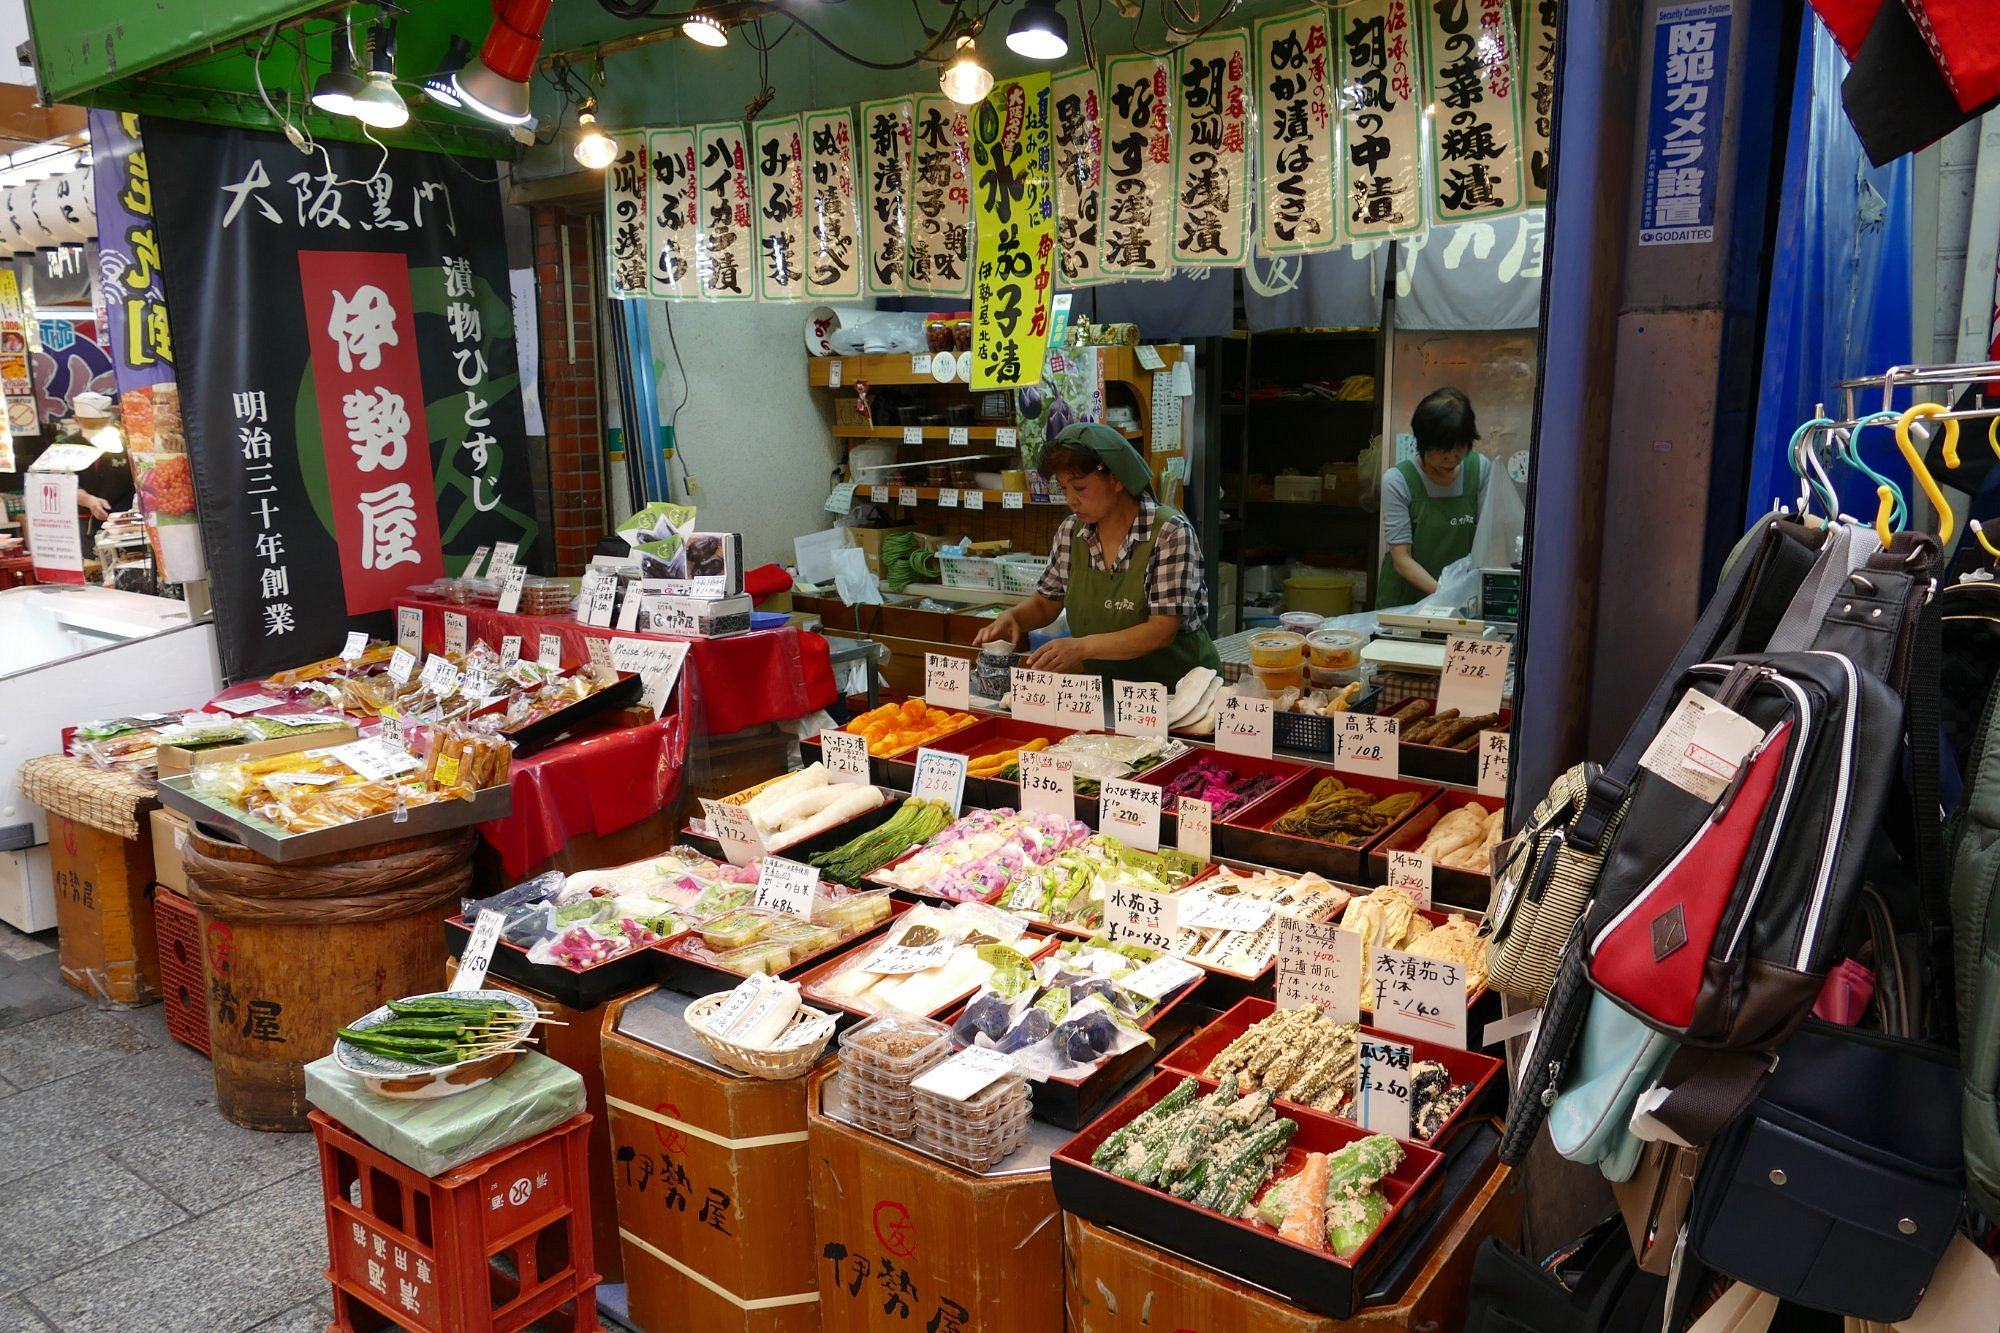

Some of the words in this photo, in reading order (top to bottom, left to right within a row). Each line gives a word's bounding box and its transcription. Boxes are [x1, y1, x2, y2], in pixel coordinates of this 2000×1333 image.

[1659, 10, 1683, 21] Security
[1684, 7, 1707, 18] Camera
[1708, 4, 1731, 15] System
[1149, 65, 1170, 164] 自家製
[1178, 58, 1230, 256] 胡瓜の浅漬
[1219, 51, 1245, 156] 自家製
[1270, 29, 1321, 241] ぬか漬はくさい
[1655, 21, 1716, 226] 防犯カメラ設置
[701, 137, 742, 293] ハイカラ漬
[1106, 78, 1156, 269] なすの浅漬
[1655, 229, 1712, 242] GODAITEC
[980, 141, 1033, 383] 水茄子漬
[327, 284, 422, 571] 伊勢屋
[441, 253, 503, 513] 漬物ひとすじ
[232, 389, 296, 638] 明治三十年創業
[1122, 686, 1160, 702] 野沢菜
[1346, 715, 1398, 734] 高菜漬
[1110, 889, 1162, 915] 水茄子
[1377, 954, 1460, 986] 浅漬茄子
[616, 1145, 732, 1237] 伊勢屋
